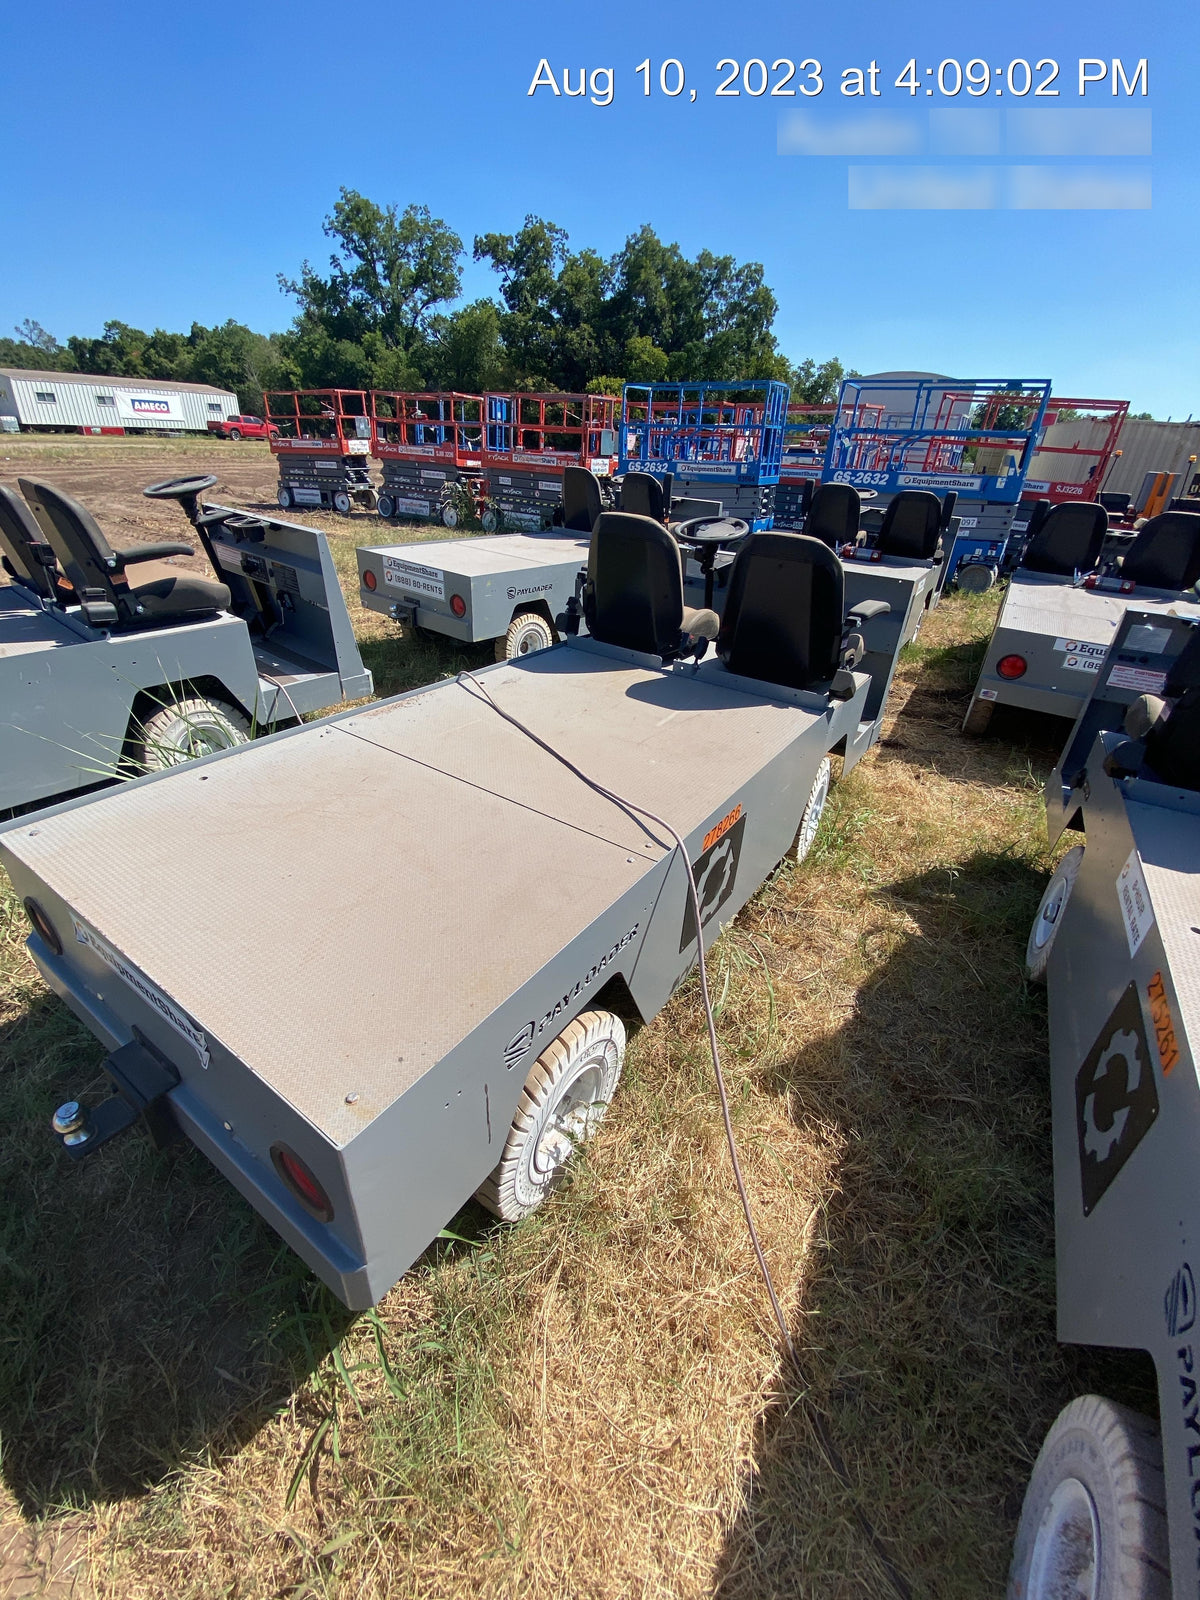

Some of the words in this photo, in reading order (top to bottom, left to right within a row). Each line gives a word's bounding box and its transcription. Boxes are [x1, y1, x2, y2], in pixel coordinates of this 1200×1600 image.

[134, 401, 168, 411] AMECO
[628, 461, 668, 473] GS-2632
[686, 464, 732, 473] EquipmentShare
[833, 471, 890, 485] GS-2632
[911, 477, 975, 488] EquipmentShare
[392, 560, 438, 578] EquipmentShare
[394, 574, 411, 586] (888)
[412, 579, 442, 595] 80-RENTS
[516, 584, 553, 596] PAYLOADER
[1079, 643, 1105, 655] Equi
[1083, 660, 1101, 670] (88
[702, 803, 742, 852] 278266
[538, 923, 640, 1036] PAYLOADER
